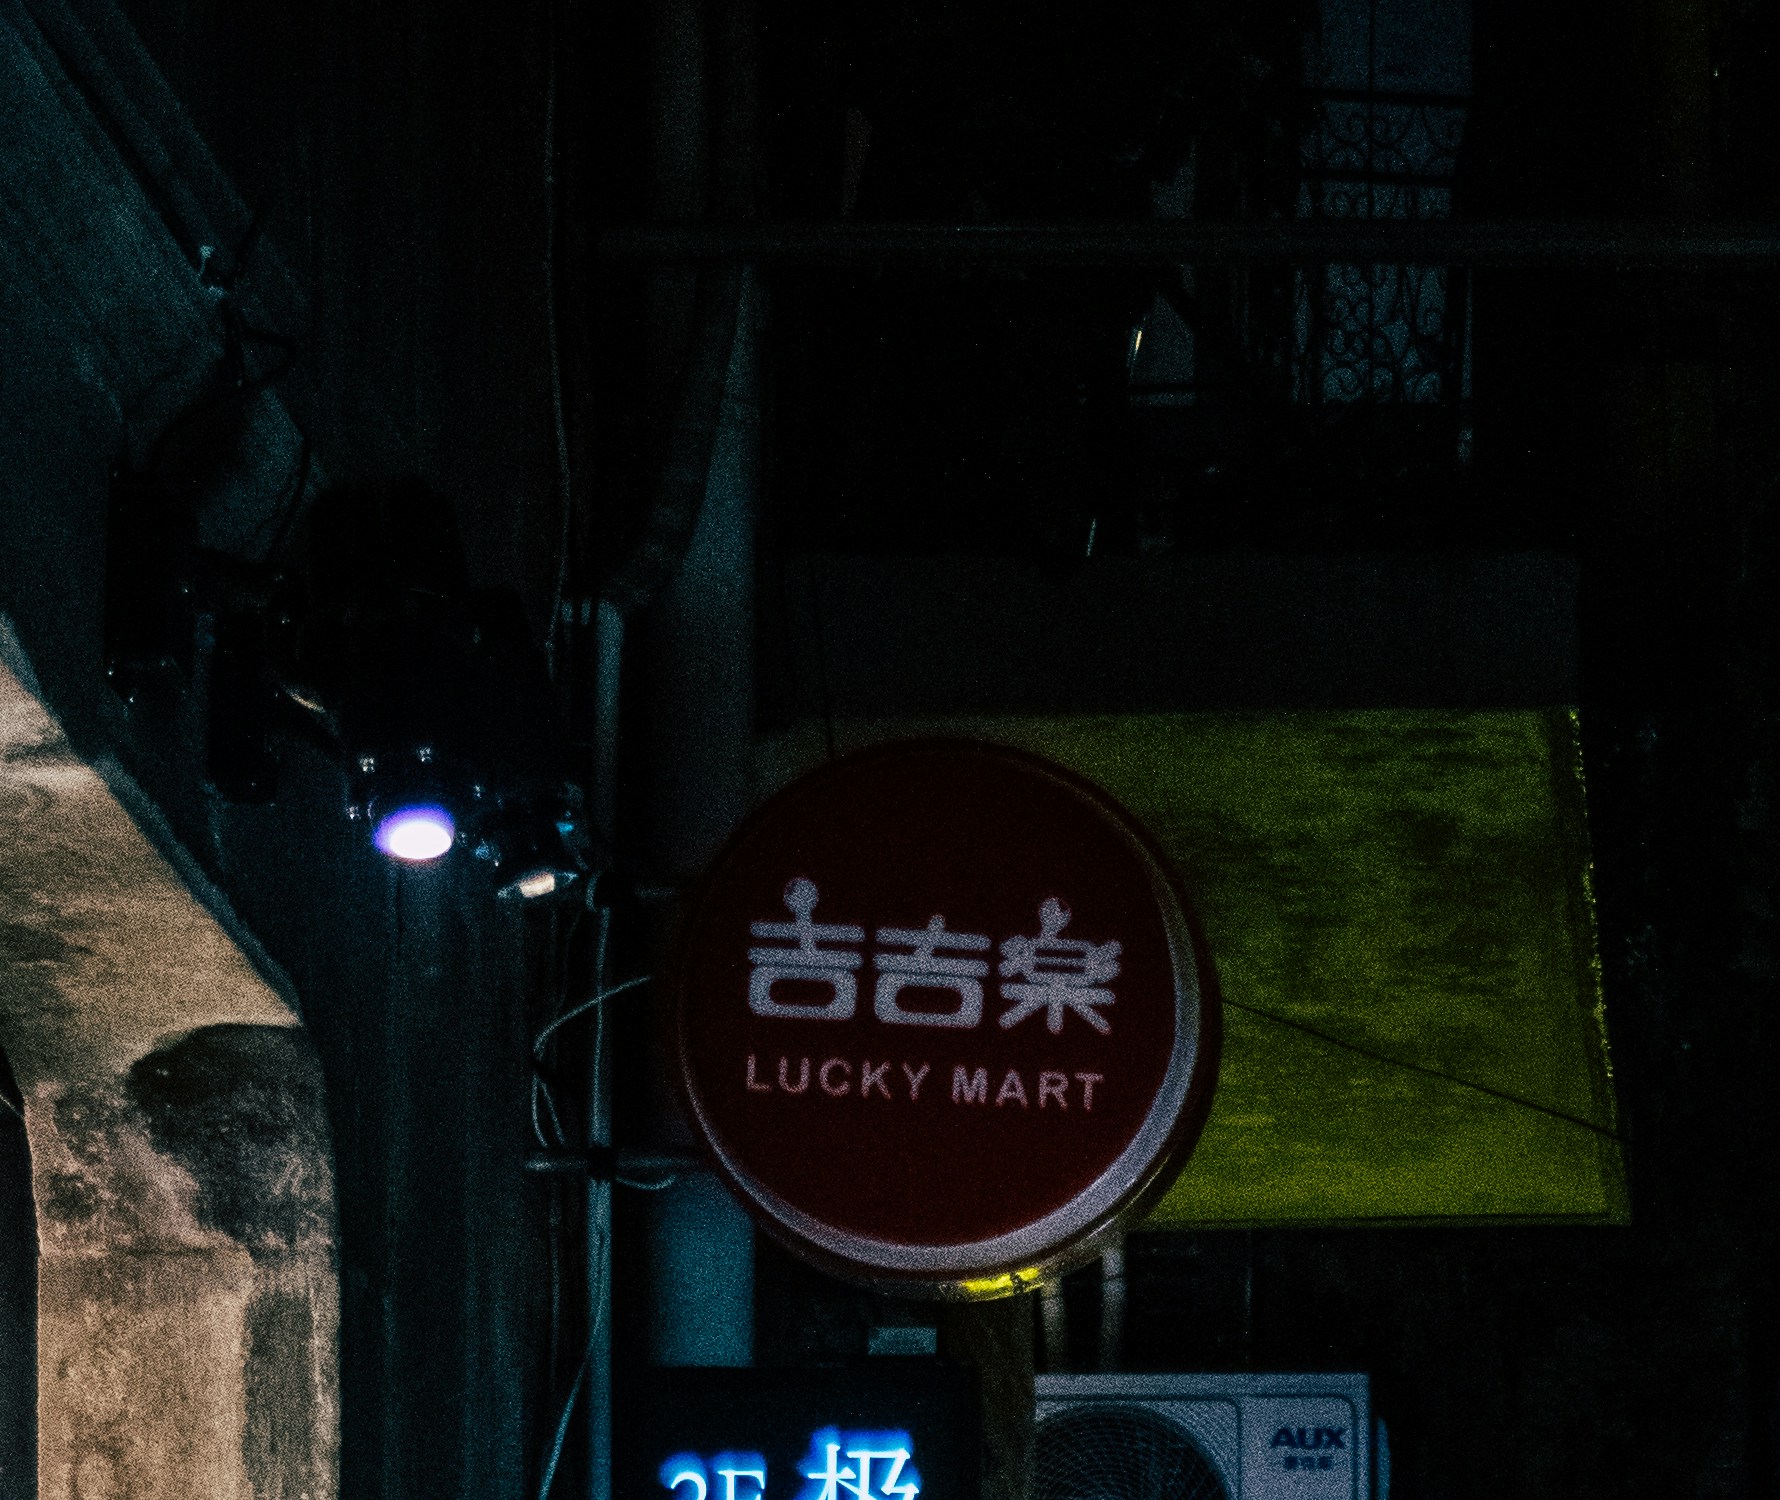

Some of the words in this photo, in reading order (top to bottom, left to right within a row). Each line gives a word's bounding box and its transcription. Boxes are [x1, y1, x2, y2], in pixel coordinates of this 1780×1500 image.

[745, 1053, 931, 1104] LUCKY
[951, 1065, 1104, 1112] MART
[1269, 1427, 1347, 1449] AUX
